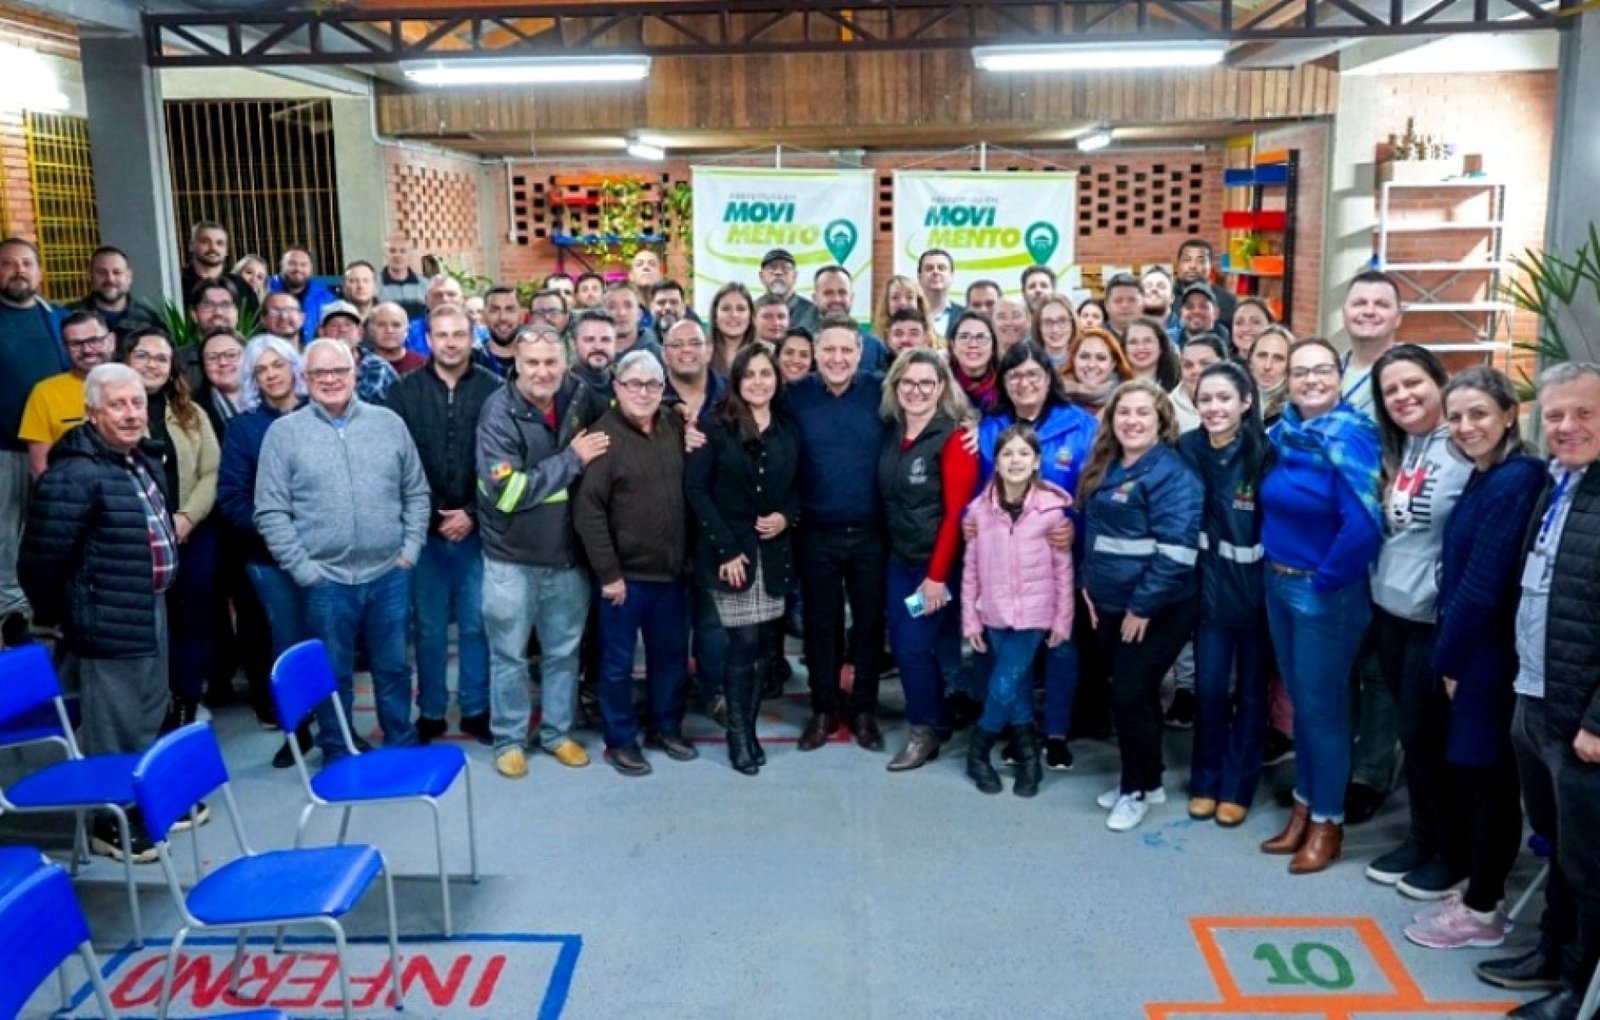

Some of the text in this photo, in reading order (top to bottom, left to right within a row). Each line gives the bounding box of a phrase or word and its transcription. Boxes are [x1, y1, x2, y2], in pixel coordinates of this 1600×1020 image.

[723, 202, 795, 222] MOVI
[924, 206, 996, 227] MOVI
[726, 225, 819, 245] MENTO
[926, 229, 1020, 248] MENTO
[1253, 942, 1355, 989] 10
[109, 953, 506, 1008] INFERNO
